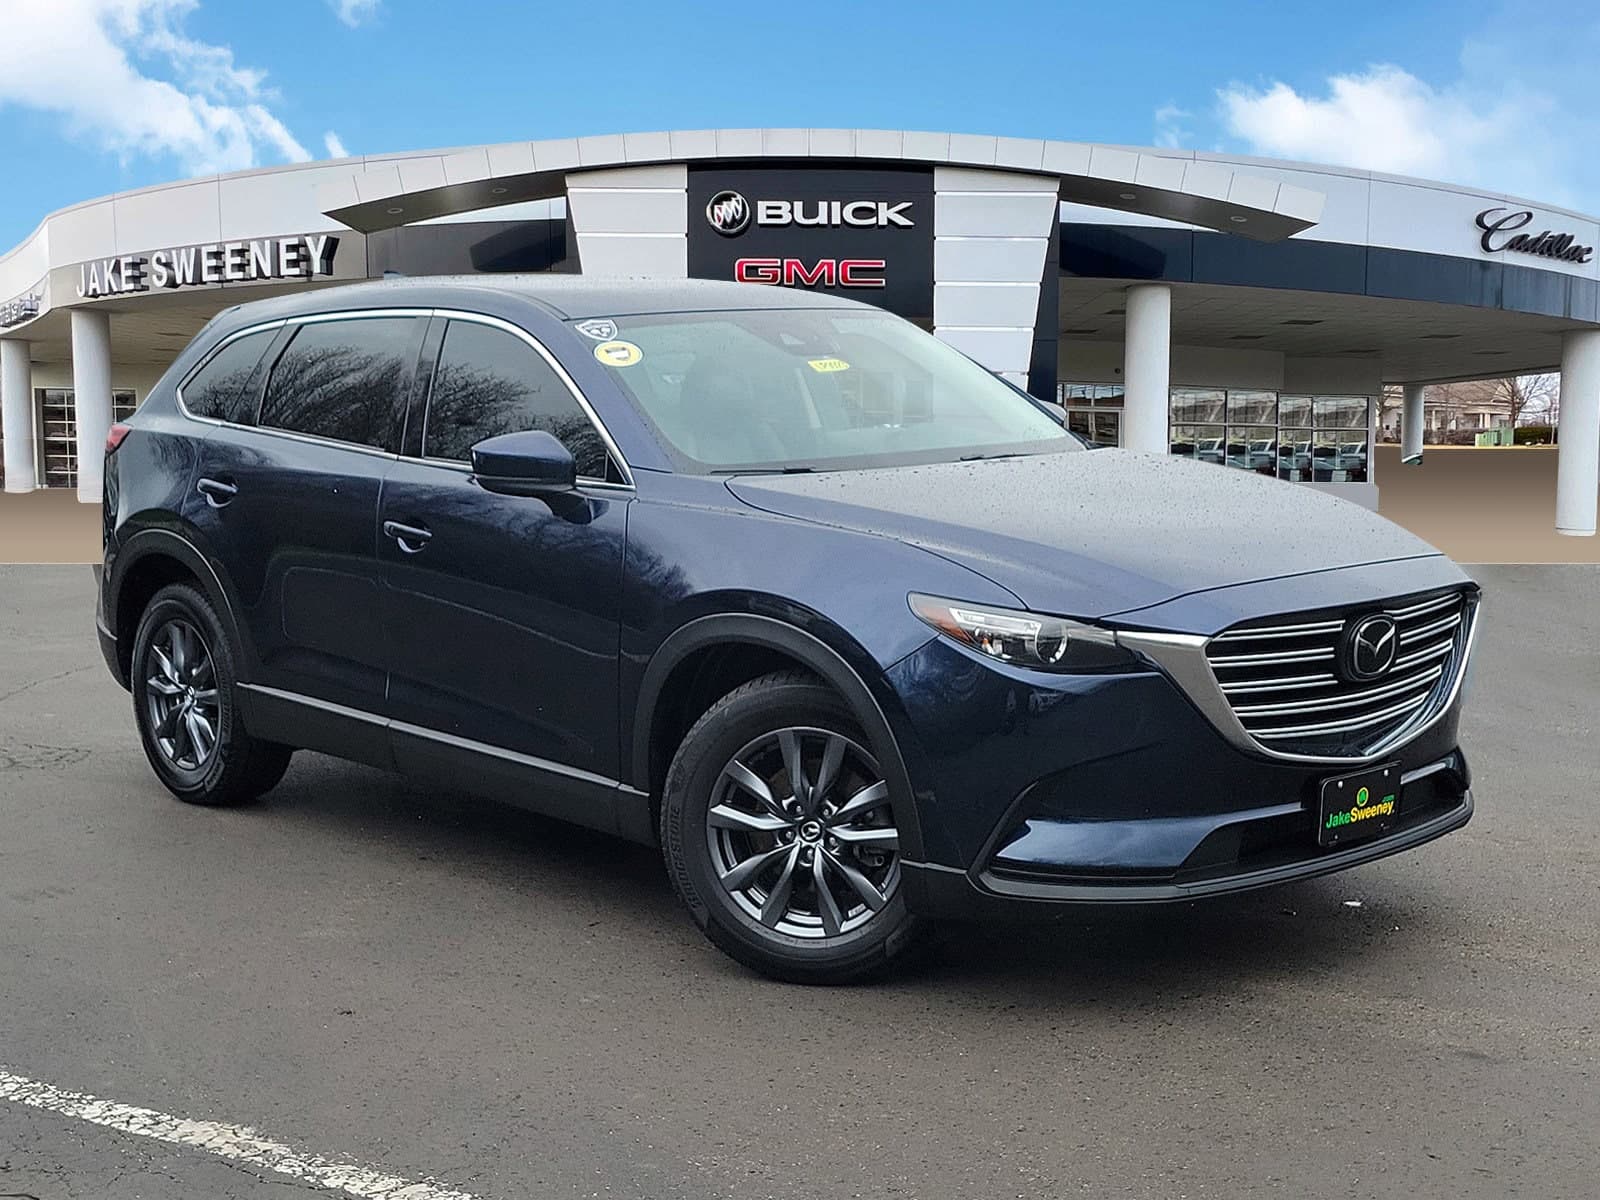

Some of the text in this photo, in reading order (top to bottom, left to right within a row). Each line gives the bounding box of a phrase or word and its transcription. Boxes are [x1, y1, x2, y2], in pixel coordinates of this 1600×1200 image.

[757, 200, 915, 226] BUICK
[1475, 207, 1594, 263] Cadillac
[76, 235, 336, 298] JAKE SWEENEY
[735, 258, 886, 286] GMC
[1325, 801, 1394, 829] JakeSweeney
